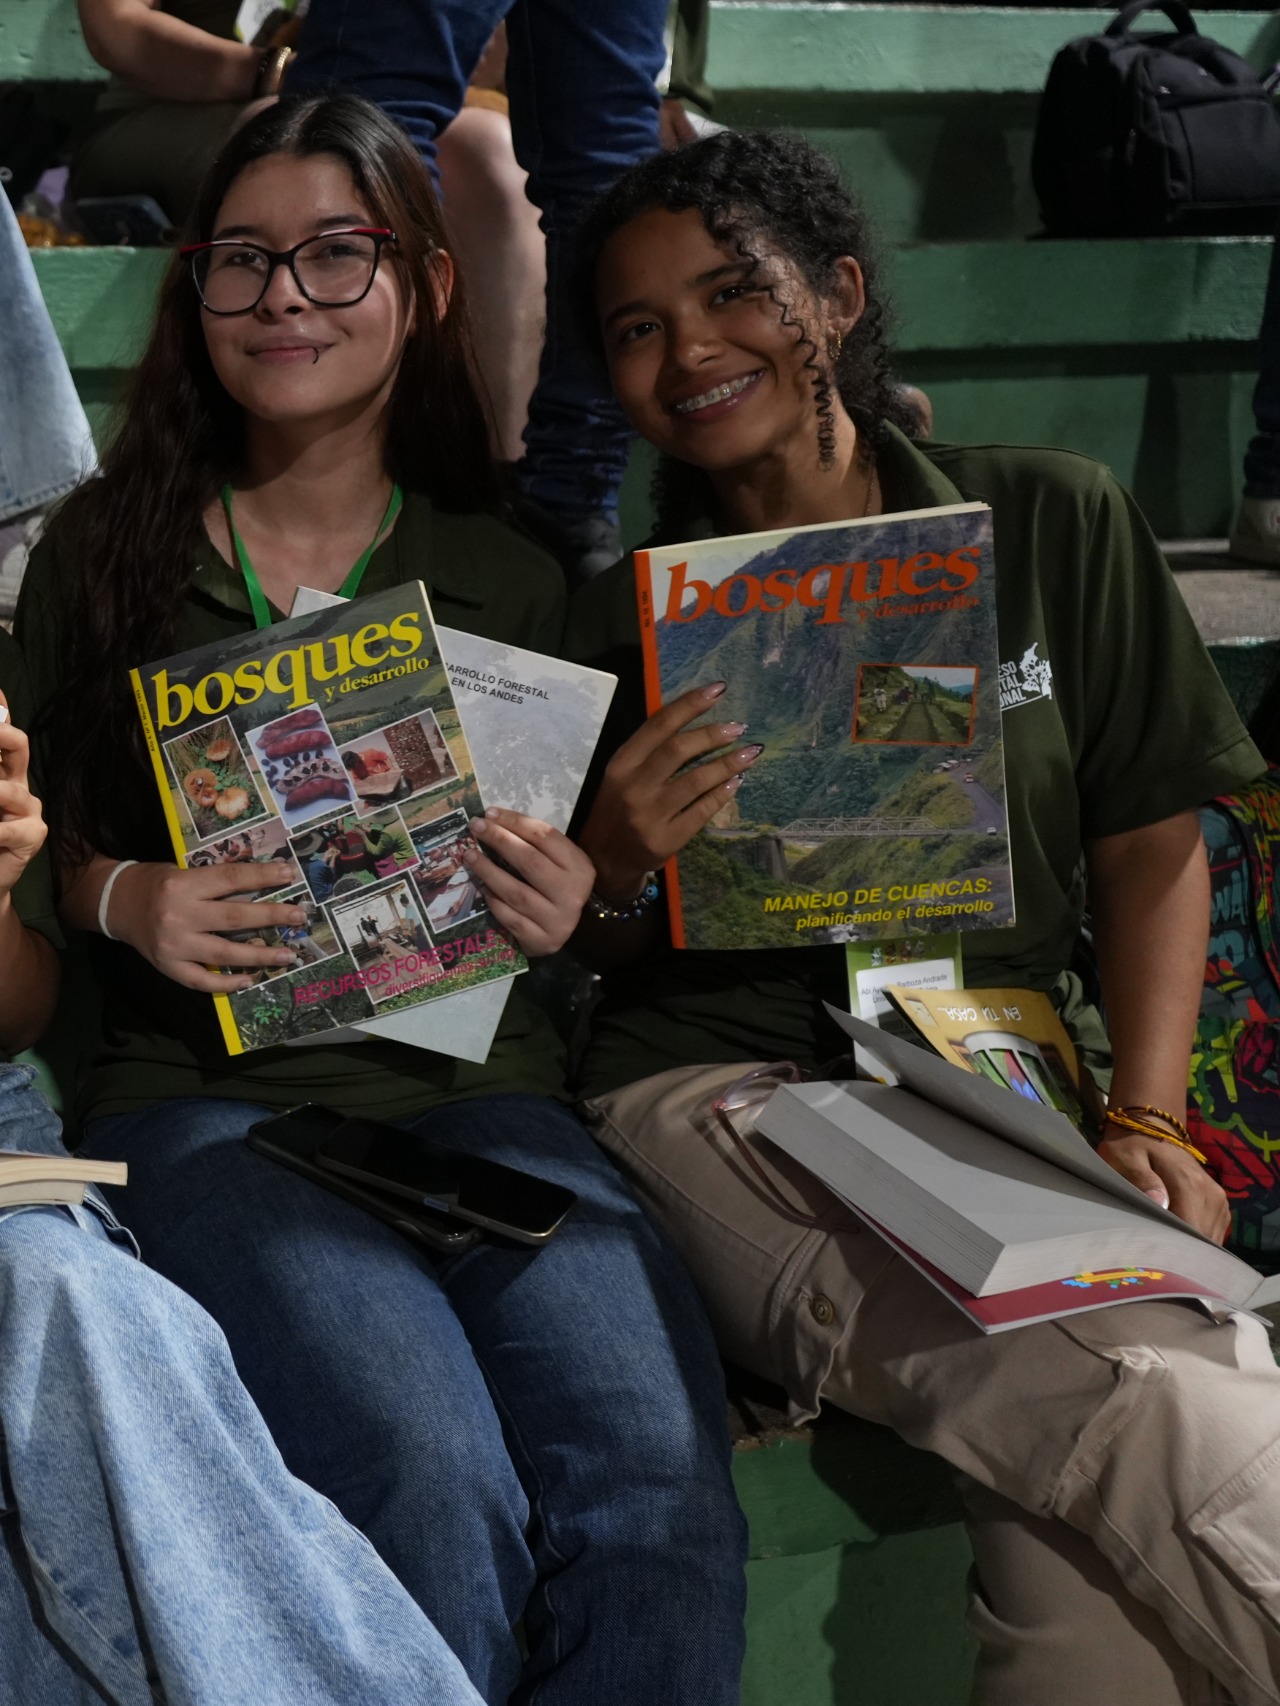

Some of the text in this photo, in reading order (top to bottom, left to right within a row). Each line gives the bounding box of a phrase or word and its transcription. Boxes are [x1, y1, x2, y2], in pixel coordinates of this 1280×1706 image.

[665, 547, 981, 625] bosques
[857, 594, 980, 624] y desarrollo
[151, 610, 422, 731] bosques
[323, 656, 430, 702] y desarrollo
[451, 677, 524, 705] EN LOS ANDES
[497, 678, 550, 701] FORESTAL
[764, 877, 993, 913] MANEJO DE CUENCAS:
[796, 899, 994, 931] planificando el desarrollo
[293, 928, 509, 1006] RECURSOS FORESTALES
[923, 974, 948, 986] Andrade
[981, 1007, 1001, 1021] TU
[1002, 1006, 1022, 1021] EN
